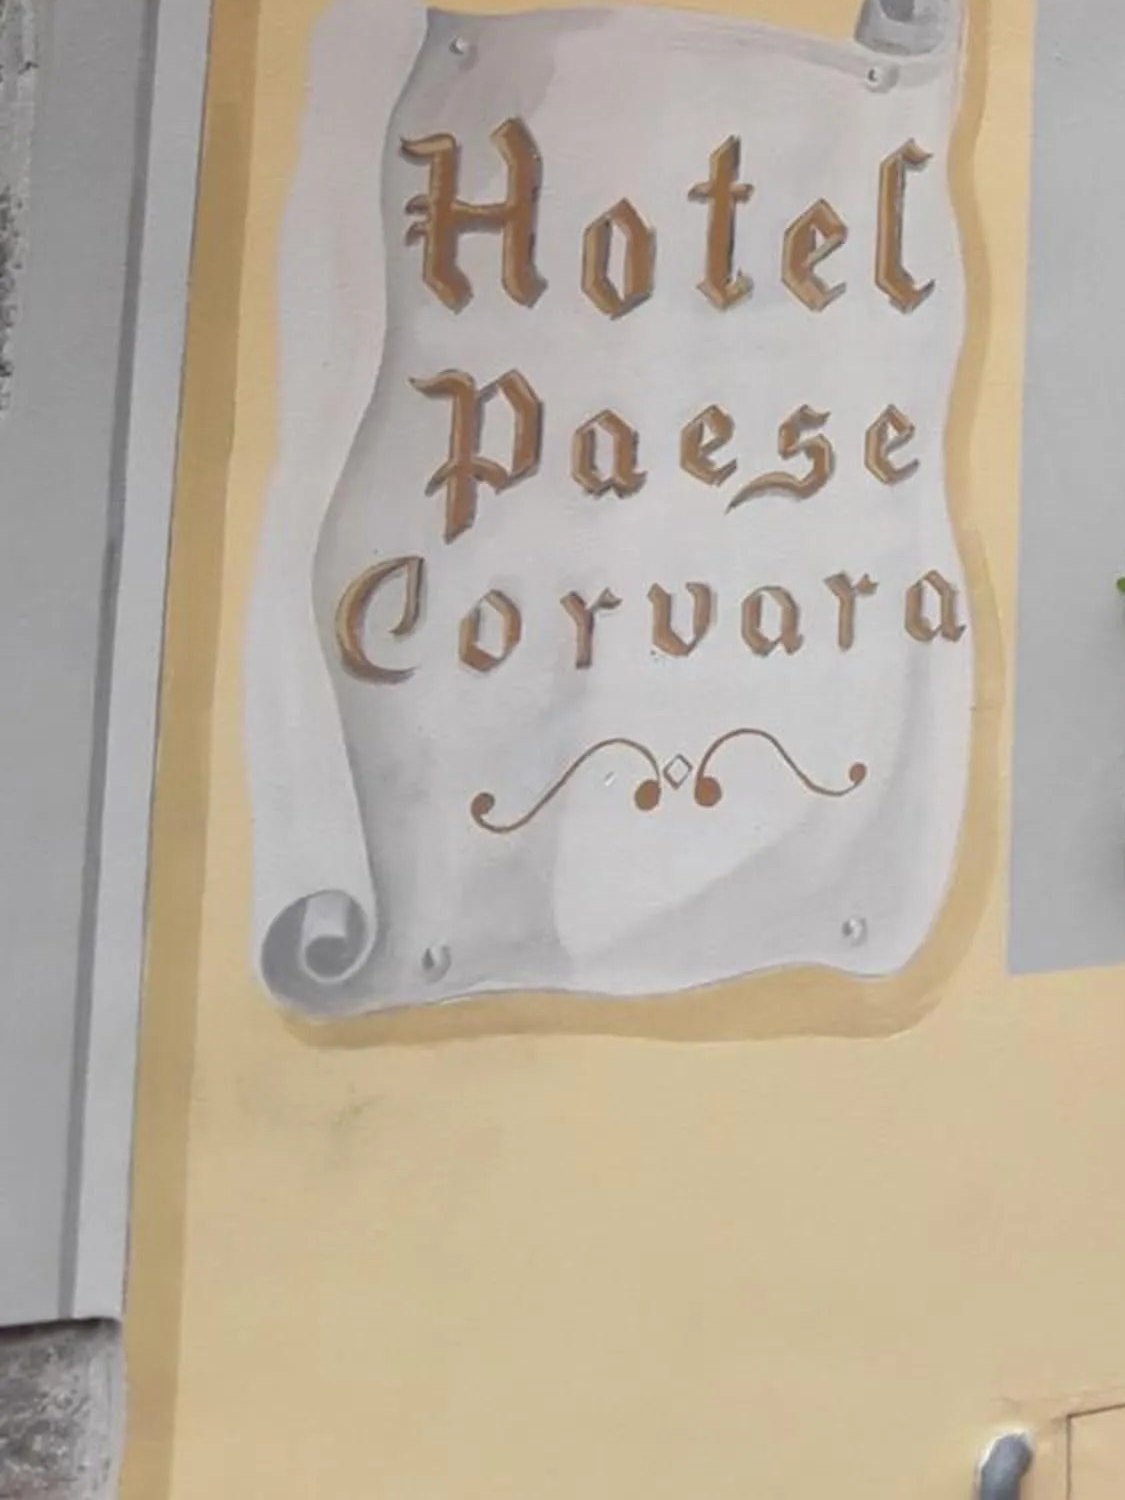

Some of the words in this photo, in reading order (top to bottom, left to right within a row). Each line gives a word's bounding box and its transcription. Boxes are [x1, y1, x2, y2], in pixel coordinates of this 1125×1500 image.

[402, 117, 935, 318] Hotel
[408, 368, 919, 544] Paese
[335, 554, 967, 683] Corvara
